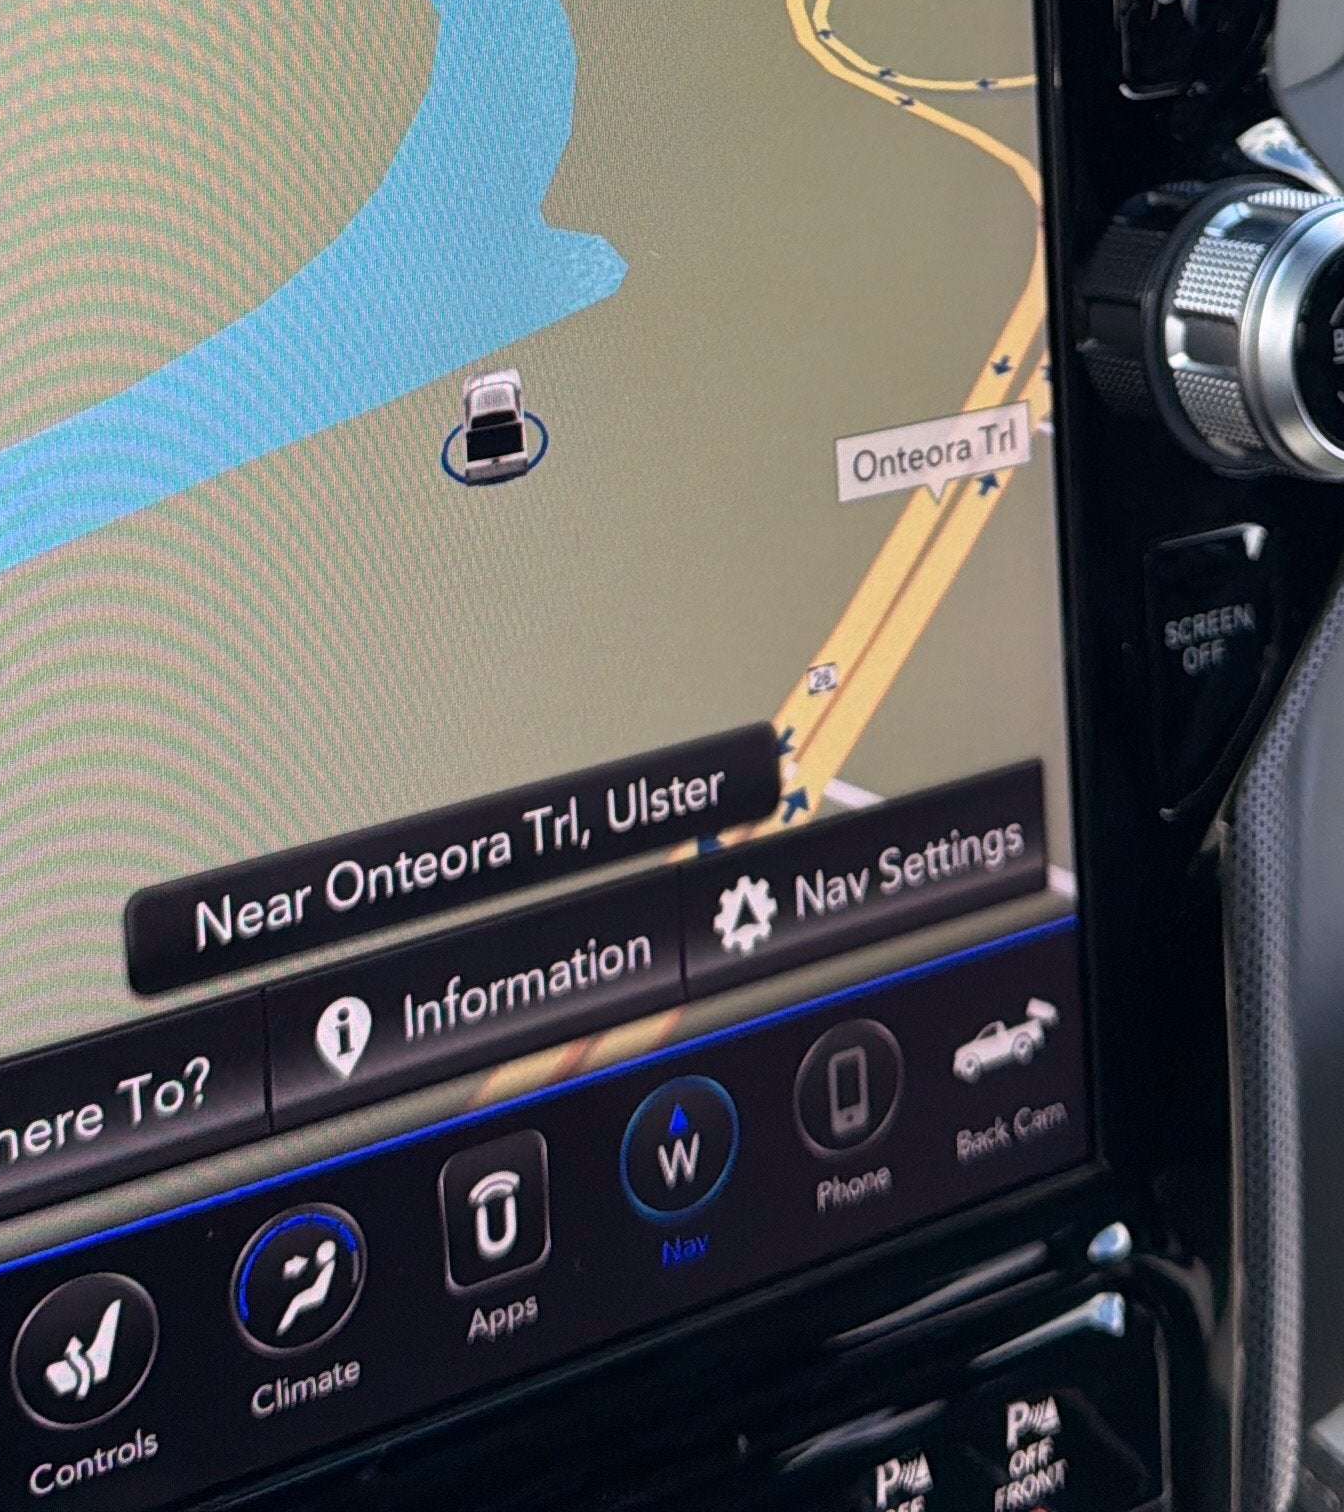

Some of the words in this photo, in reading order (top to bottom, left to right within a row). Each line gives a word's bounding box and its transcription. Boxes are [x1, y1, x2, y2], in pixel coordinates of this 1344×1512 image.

[852, 434, 973, 485] Onteora
[978, 418, 1017, 458] Trl
[1164, 603, 1256, 650] SCREEN
[1182, 638, 1228, 677] OFF
[195, 876, 314, 953] Near
[324, 827, 514, 915] Onteora
[523, 797, 592, 858] Trl,
[605, 763, 727, 830] Ulster
[793, 862, 869, 920] Nav
[878, 815, 1026, 892] Settings
[402, 929, 653, 1043] Information
[118, 1055, 213, 1131] To?
[658, 1130, 702, 1188] W
[955, 1110, 1011, 1163] Back
[1012, 1102, 1070, 1145] Cam
[816, 1163, 893, 1213] Phone
[661, 1231, 711, 1269] Nav
[467, 1291, 539, 1343] Apps
[251, 1356, 361, 1421] Climate
[28, 1428, 159, 1497] Controls
[994, 1457, 1069, 1512] FRONT
[1008, 1436, 1055, 1481] OFF
